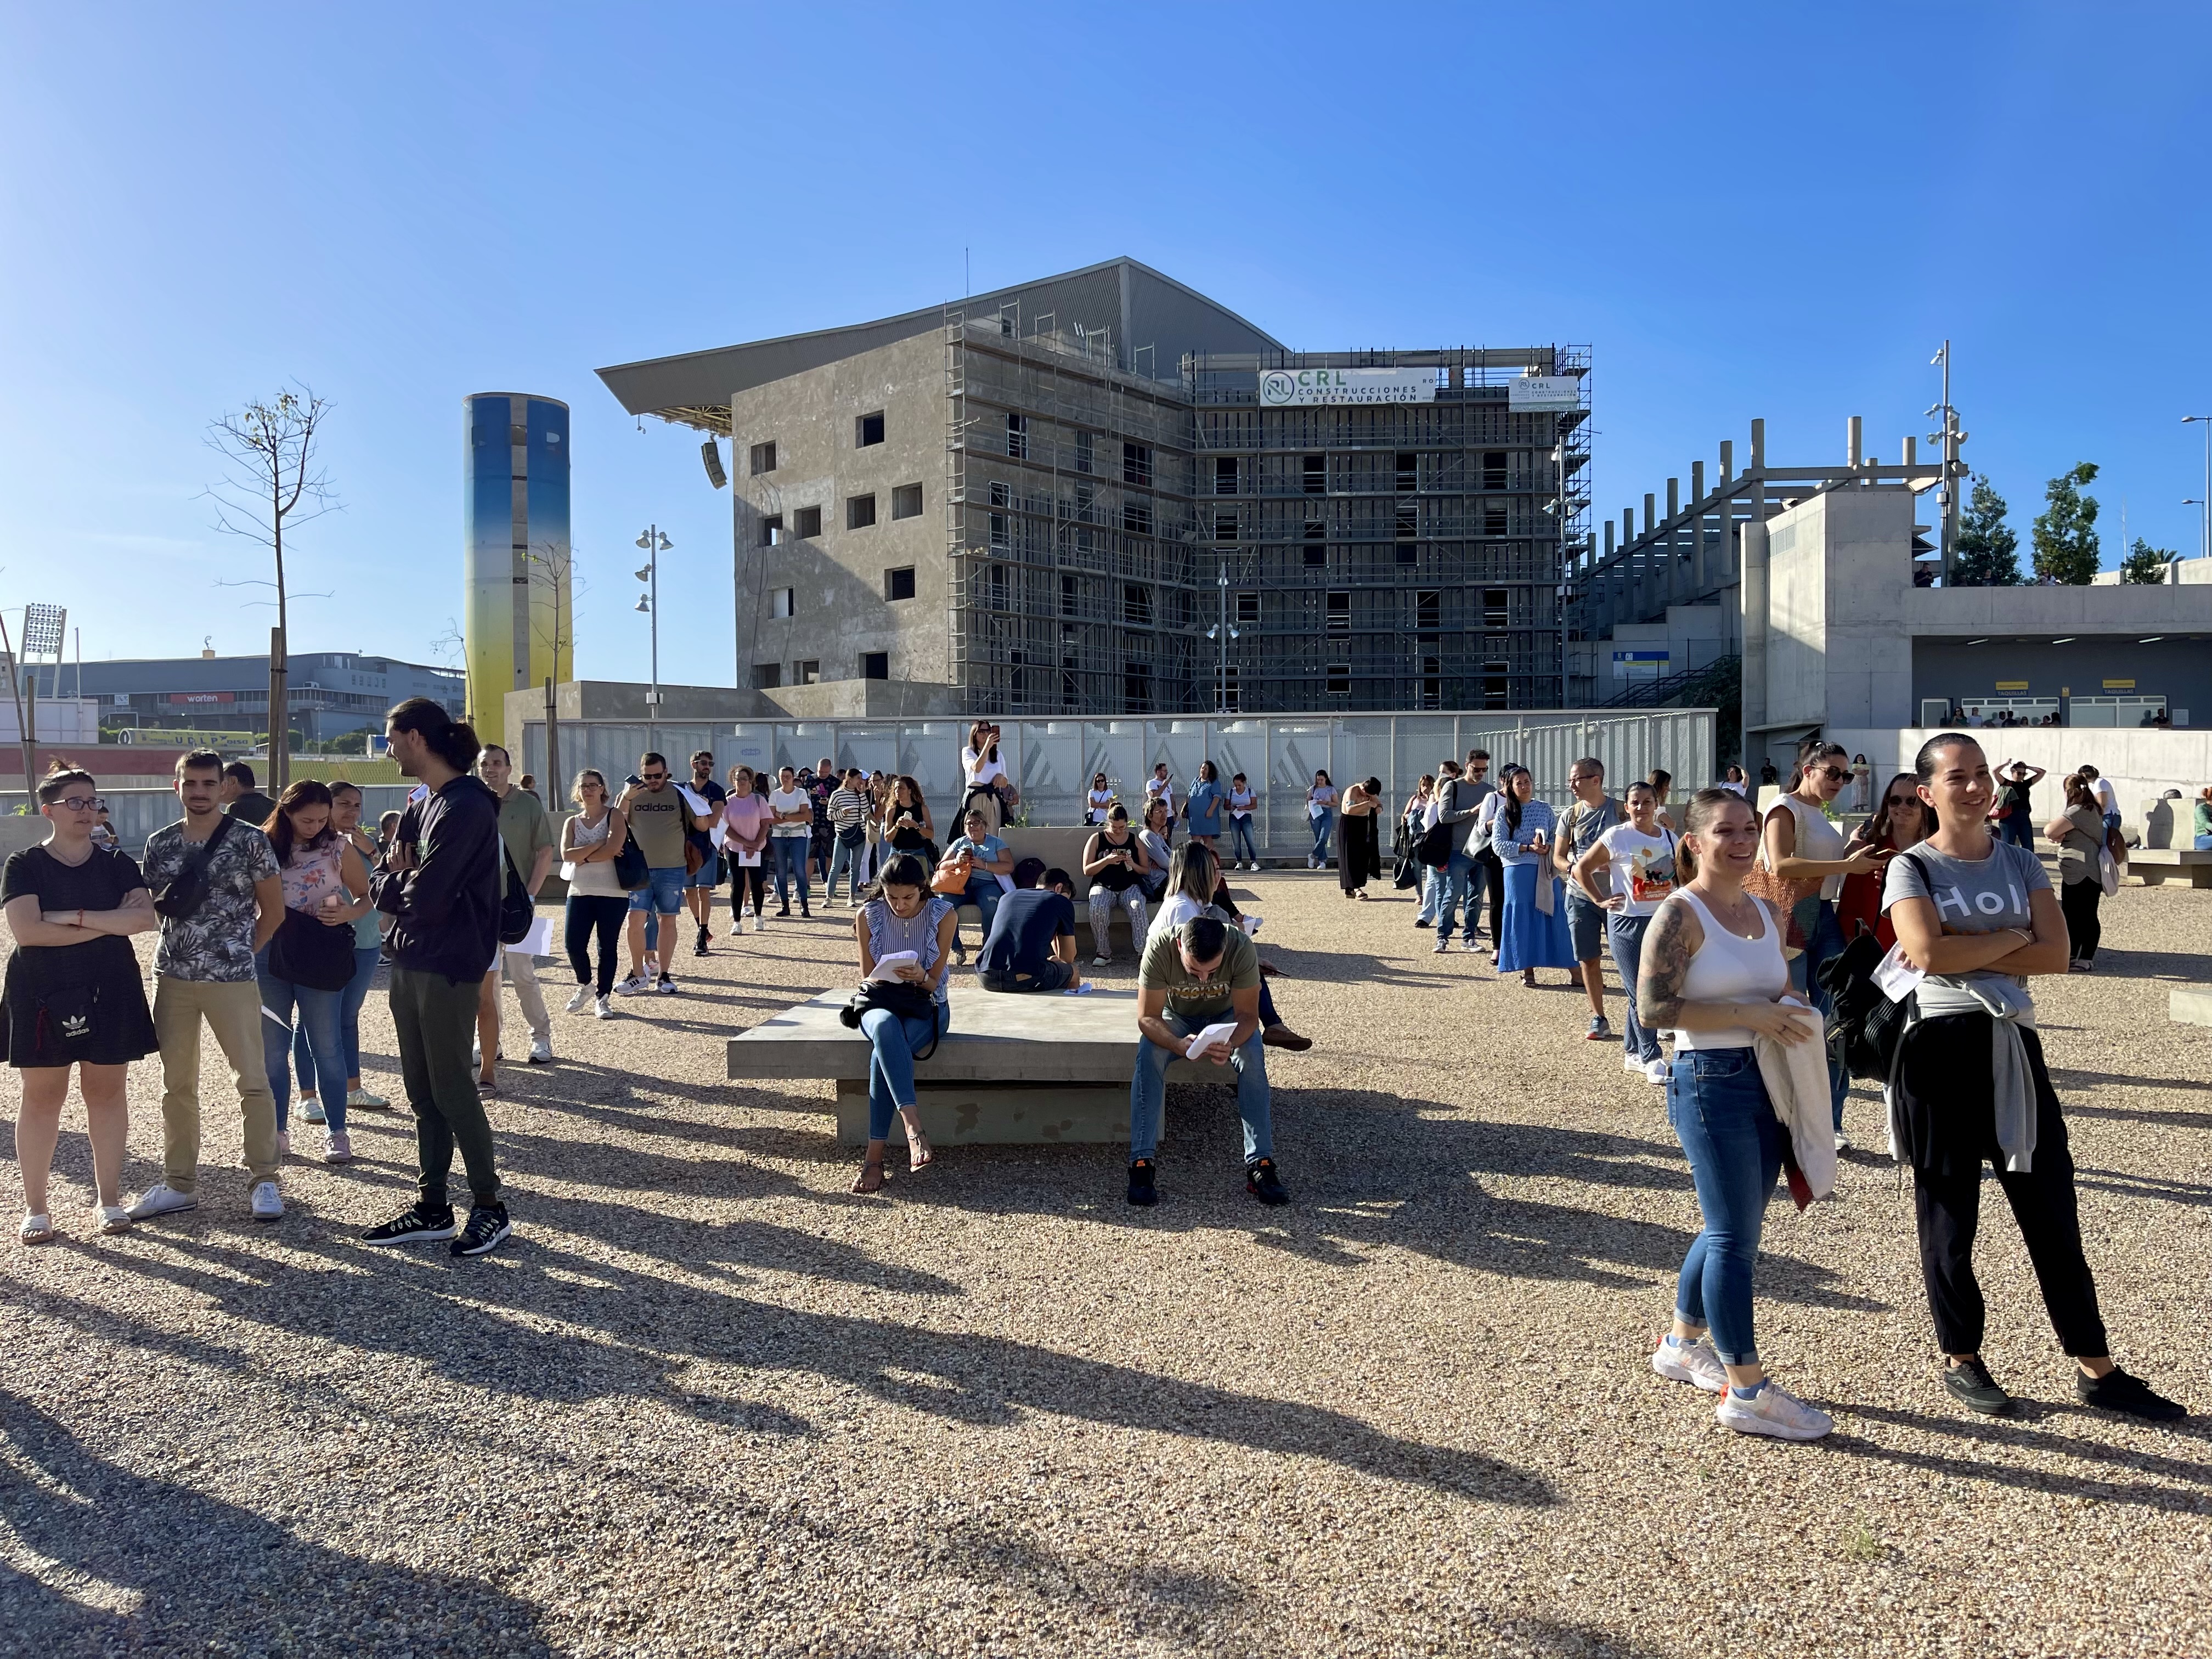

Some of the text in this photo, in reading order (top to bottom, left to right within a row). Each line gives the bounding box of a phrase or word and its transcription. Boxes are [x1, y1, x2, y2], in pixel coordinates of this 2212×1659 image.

[1298, 371, 1346, 386] CRL
[1299, 386, 1416, 395] CONSTRUCCIONES
[1313, 394, 1416, 403] RESTAURACIÓN
[635, 803, 675, 811] adidas
[1933, 884, 2031, 923] Hol
[66, 1028, 90, 1037] adidas
